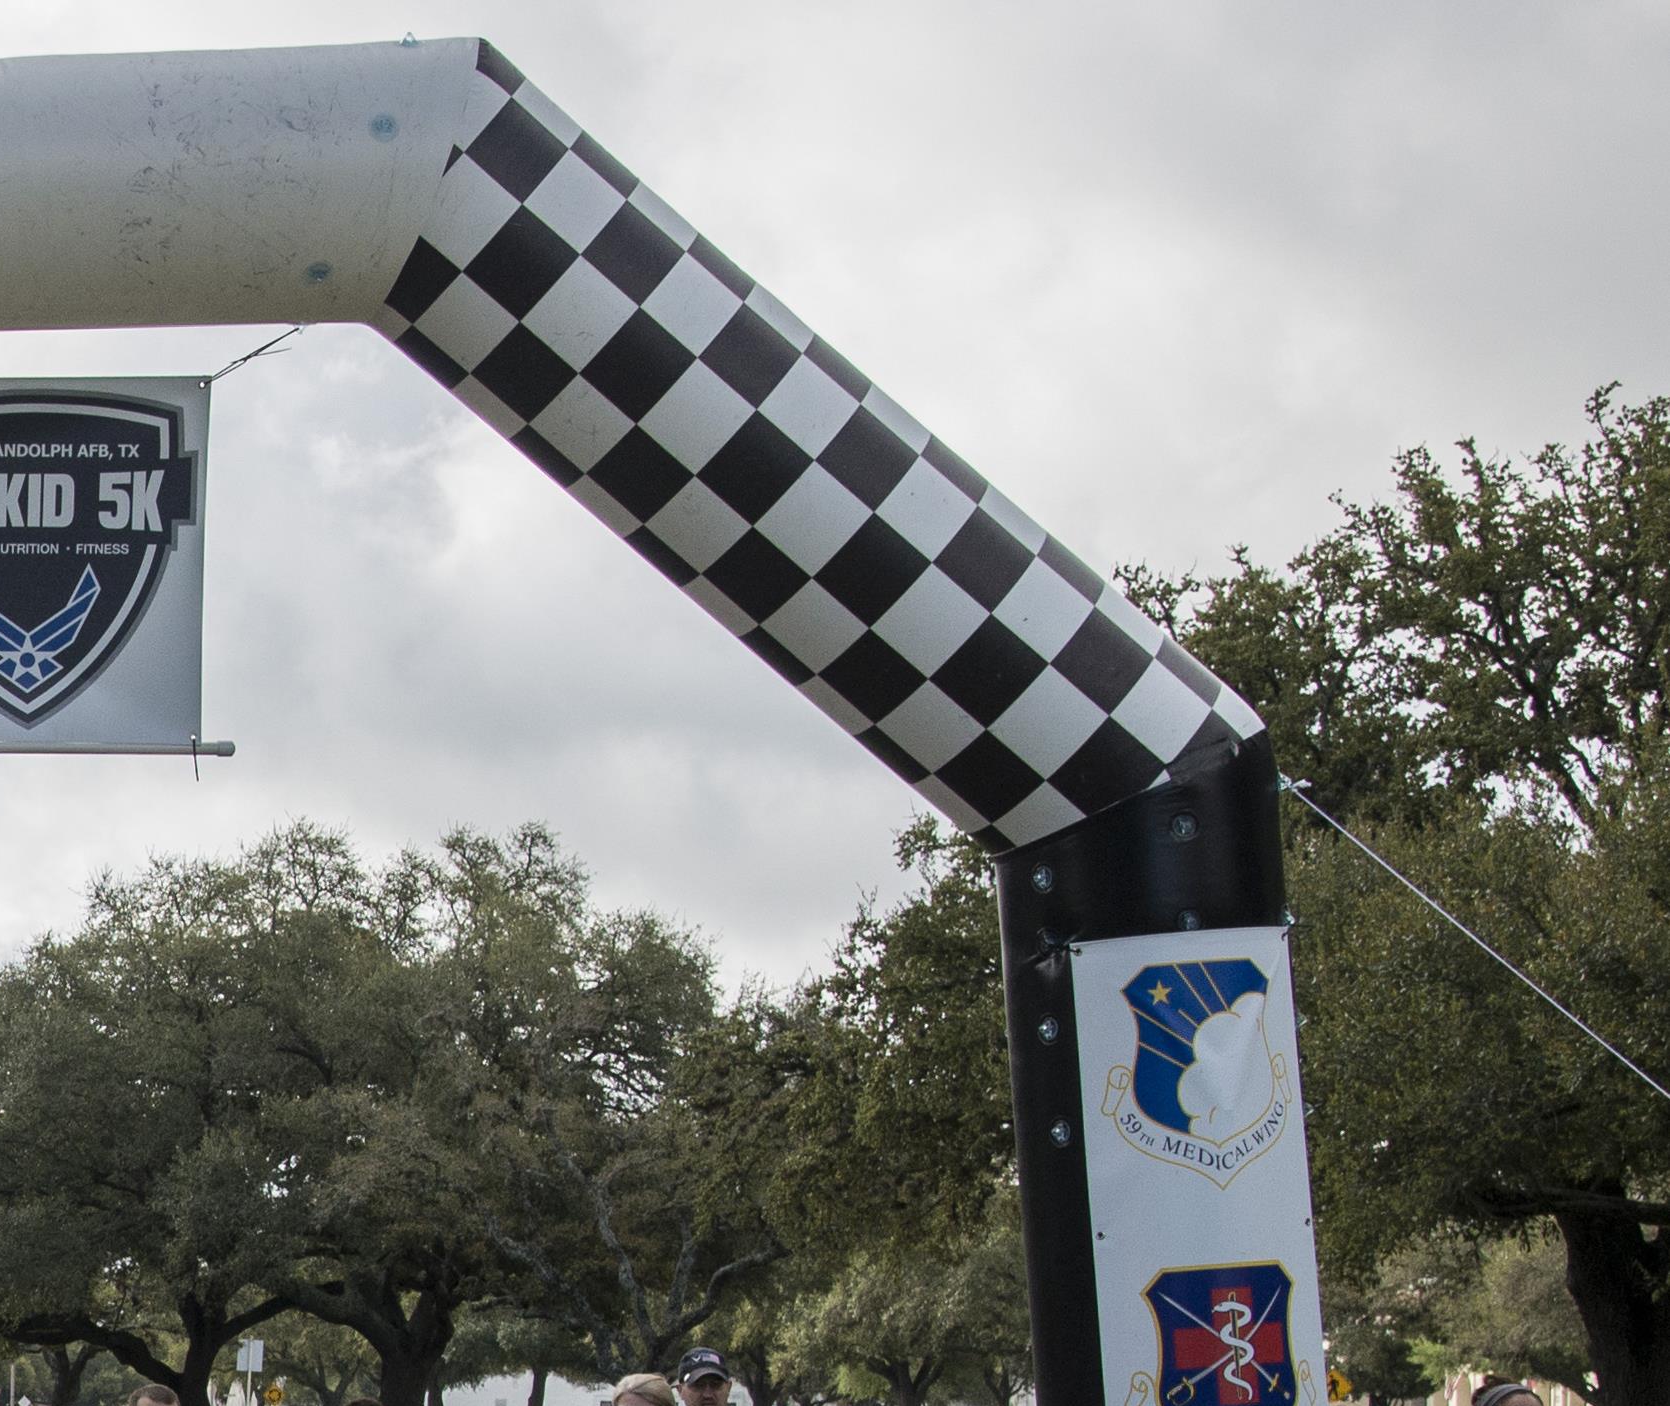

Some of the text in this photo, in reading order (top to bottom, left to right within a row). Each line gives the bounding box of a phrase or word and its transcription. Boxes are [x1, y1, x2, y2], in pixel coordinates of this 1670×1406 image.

[77, 444, 114, 461] AFB,
[117, 444, 140, 458] TX
[98, 470, 166, 533] 5K
[76, 543, 130, 556] FITNESS
[1162, 1136, 1253, 1171] MEDICAL
[1253, 1100, 1285, 1145] WING
